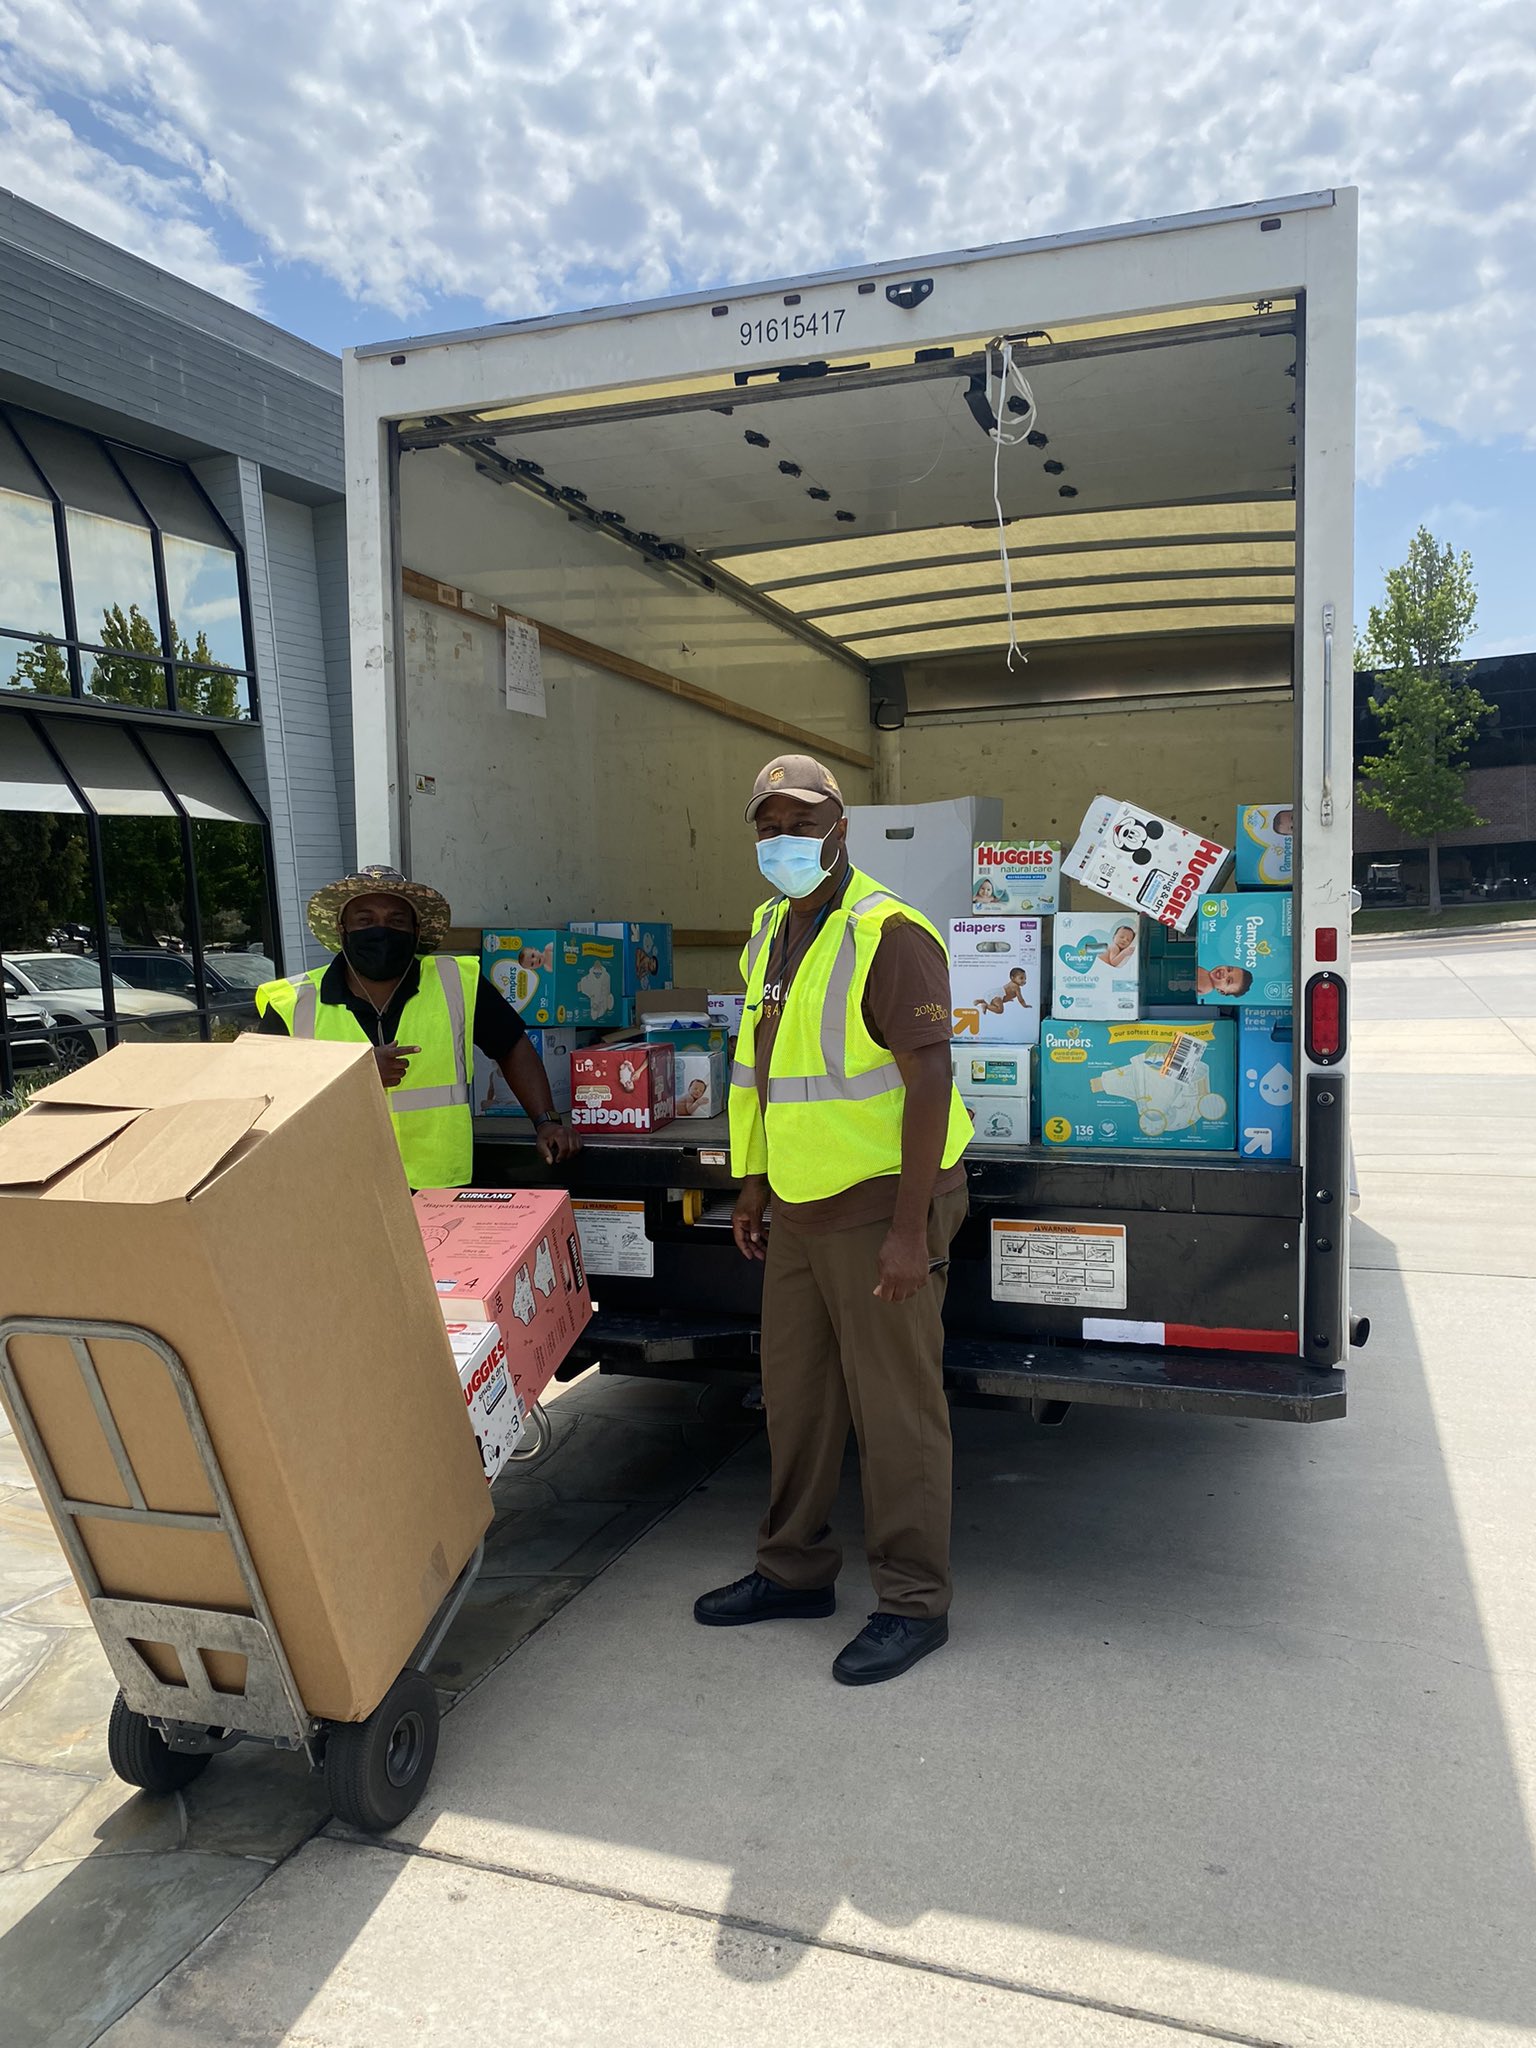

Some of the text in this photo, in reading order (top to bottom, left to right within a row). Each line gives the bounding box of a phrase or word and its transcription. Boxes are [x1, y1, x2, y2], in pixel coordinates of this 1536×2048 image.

[740, 309, 846, 346] 91615417
[977, 847, 1053, 866] HUGGIES
[1280, 836, 1292, 873] Pampers
[1000, 865, 1032, 873] natural
[1157, 839, 1223, 929] HUGGIES
[1163, 870, 1180, 893] snug
[1160, 890, 1169, 899] &
[1151, 898, 1165, 915] dry
[1207, 903, 1217, 914] 3
[953, 921, 1006, 935] diapers
[1208, 919, 1217, 933] 104
[1025, 934, 1032, 943] 3
[1233, 925, 1243, 961] baby-dry
[1245, 915, 1264, 969] Pampers
[1064, 952, 1094, 963] Pampers
[506, 966, 517, 1004] Pampers
[913, 1003, 936, 1017] 20M
[930, 1008, 948, 1022] 2020
[1245, 1017, 1266, 1025] free
[1046, 1033, 1092, 1049] Pampers
[571, 1108, 650, 1128] HUGGIES
[1053, 1120, 1064, 1134] 3
[1075, 1125, 1094, 1136] 136
[551, 1227, 561, 1261] diapers
[569, 1236, 584, 1287] KIRKLAND
[464, 1277, 480, 1289] 4
[494, 1291, 504, 1314] 180
[464, 1337, 505, 1407] UGGIES
[513, 1373, 522, 1387] 4
[478, 1384, 492, 1402] snug
[495, 1362, 505, 1378] dry
[510, 1414, 520, 1434] 3
